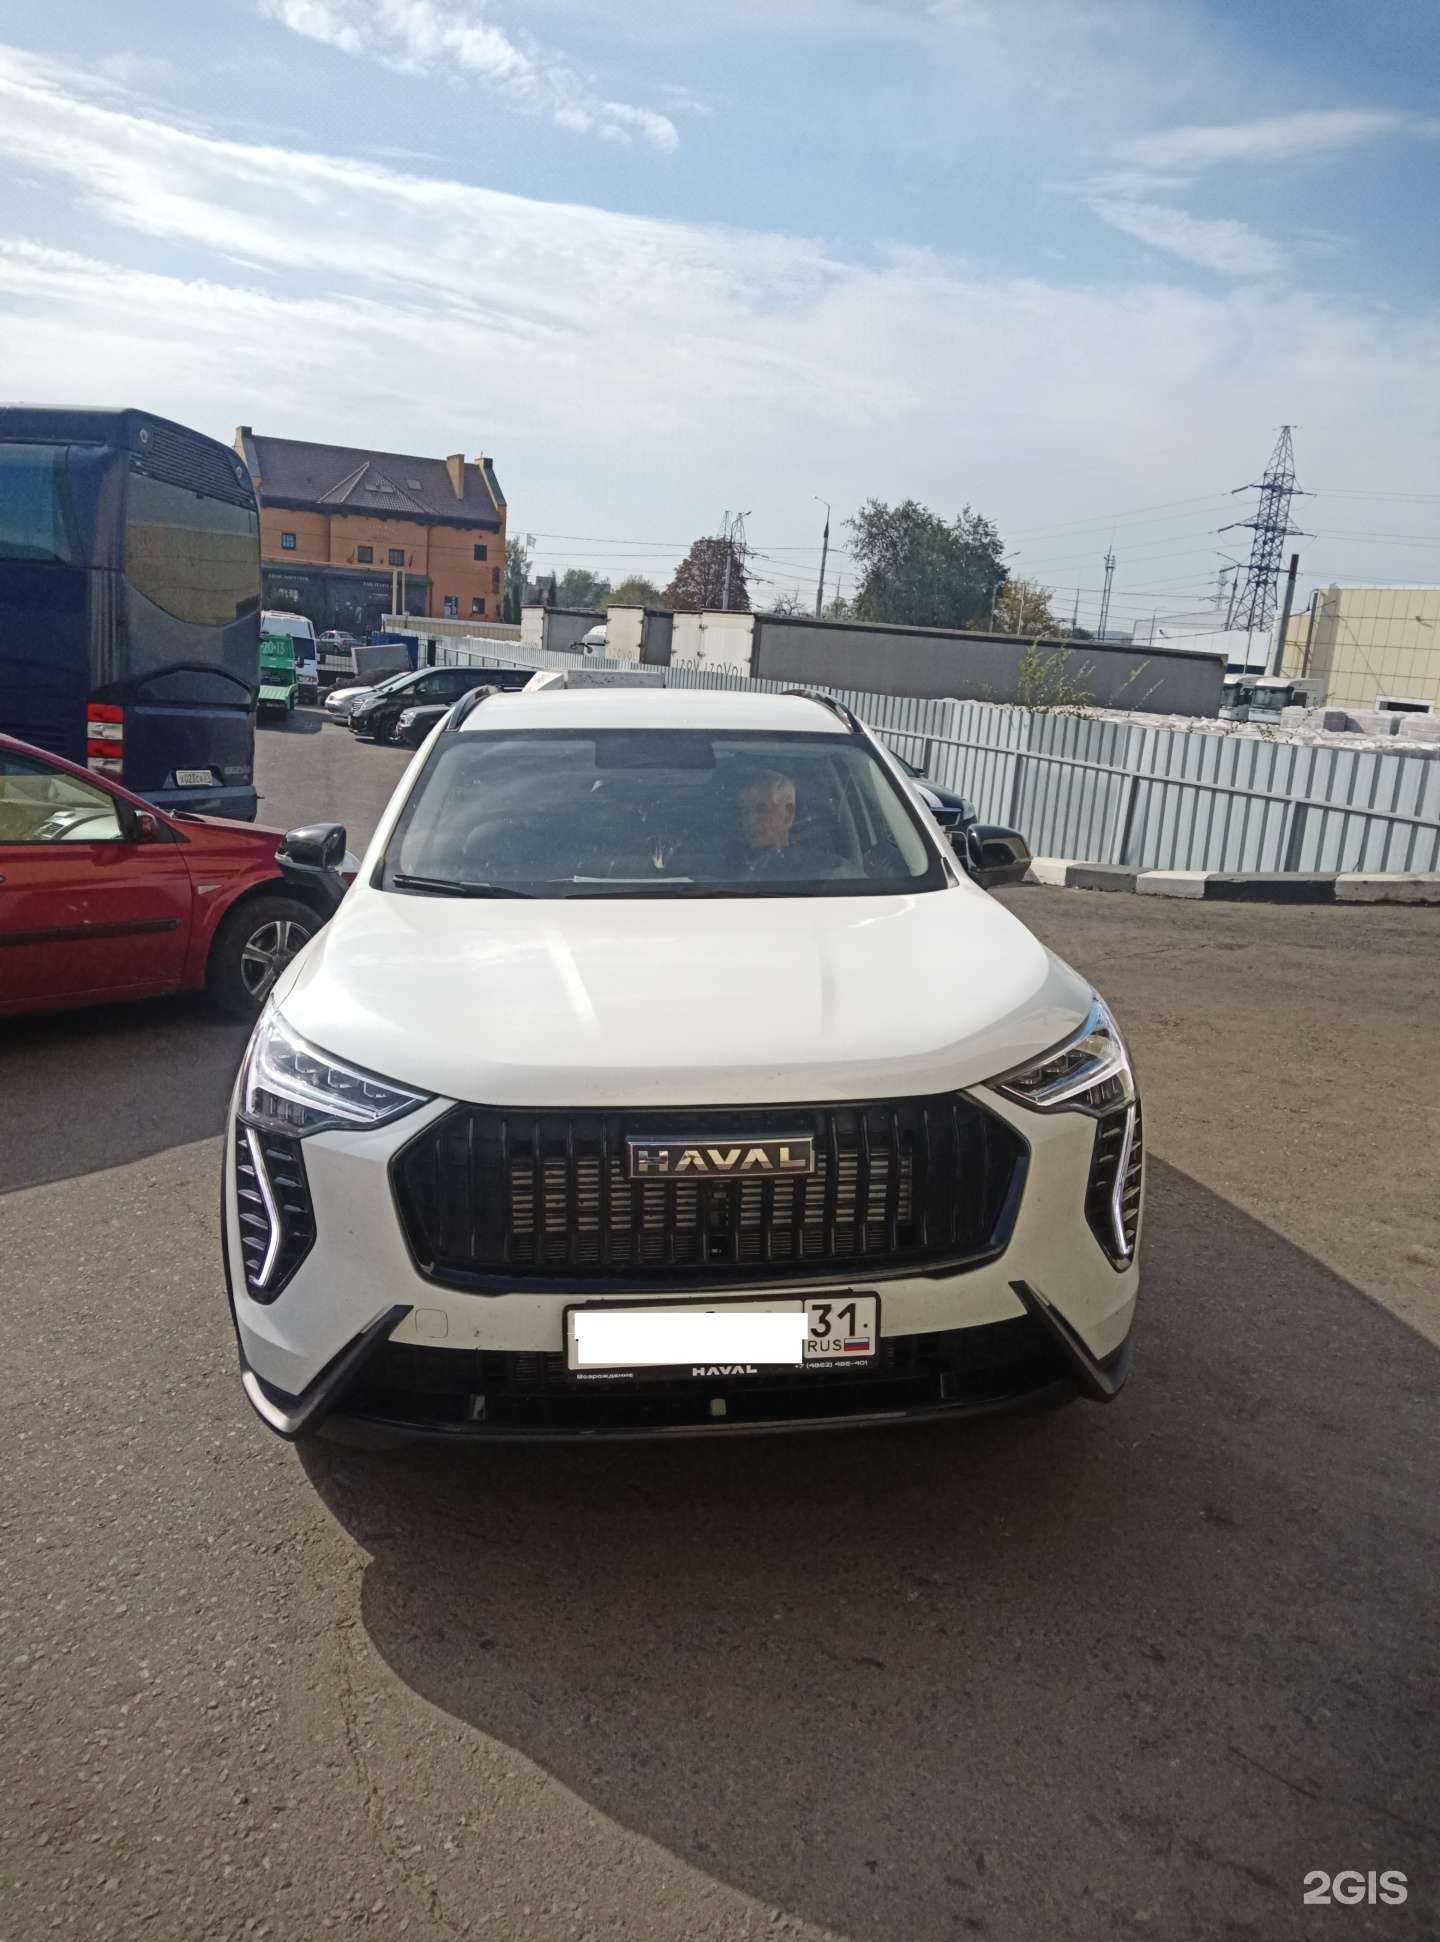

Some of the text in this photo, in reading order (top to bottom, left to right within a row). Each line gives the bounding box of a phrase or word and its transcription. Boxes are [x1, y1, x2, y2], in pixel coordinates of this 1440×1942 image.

[637, 1147, 807, 1172] HAVAL
[810, 1303, 856, 1338] 31
[807, 1339, 842, 1352] RUS
[692, 1364, 758, 1377] HAVAL
